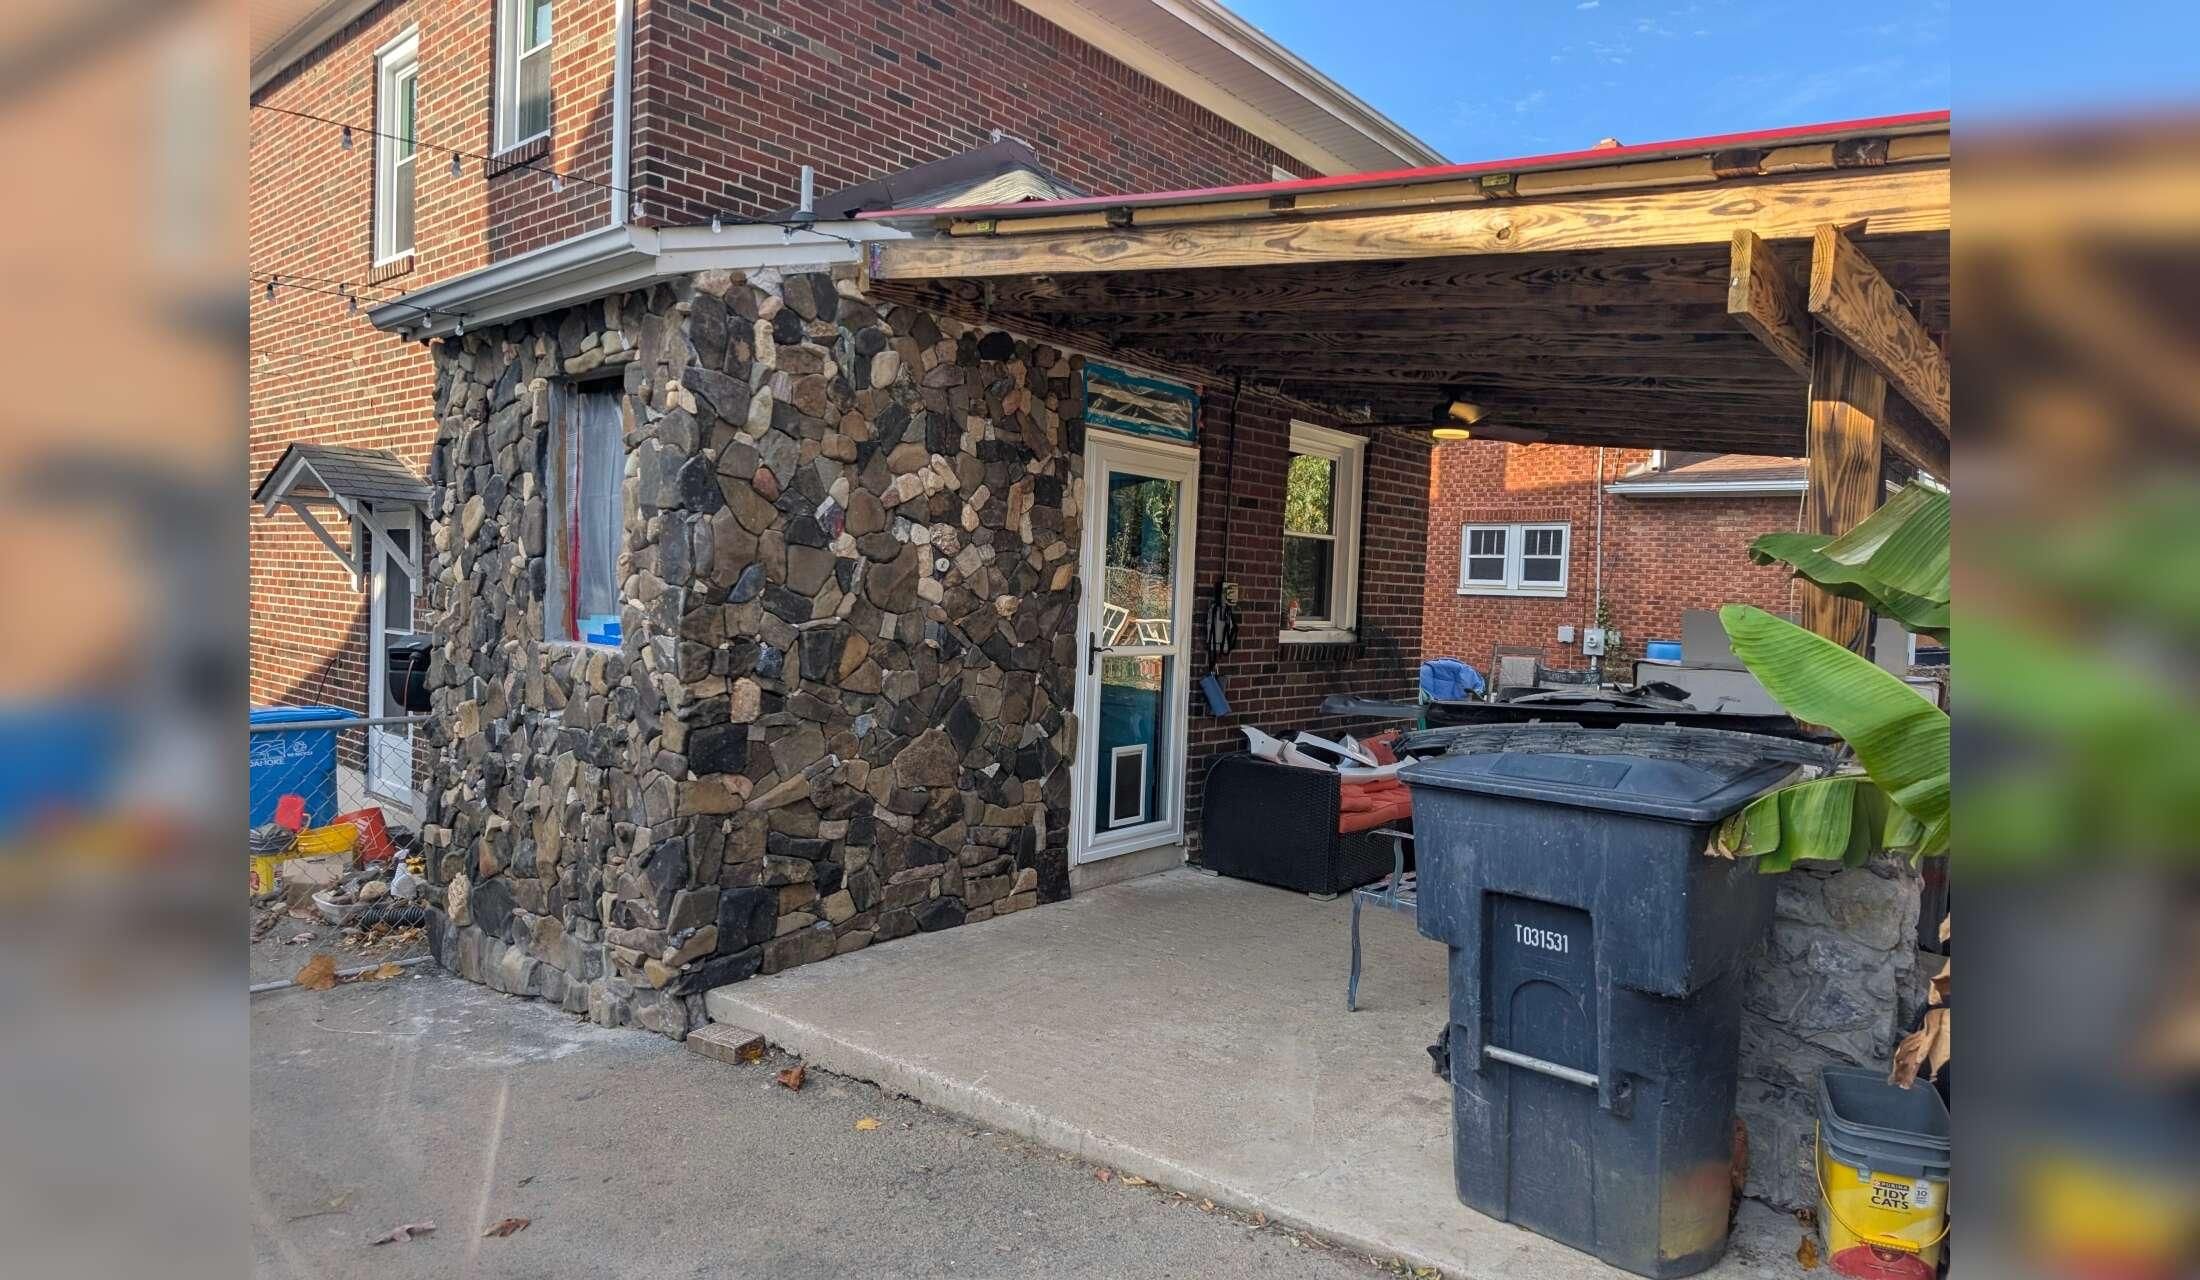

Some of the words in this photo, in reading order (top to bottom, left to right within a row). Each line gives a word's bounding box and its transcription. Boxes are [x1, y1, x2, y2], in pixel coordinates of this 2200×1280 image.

[1514, 923, 1569, 954] T031531
[1873, 1187, 1908, 1200] TIDY
[1871, 1196, 1909, 1210] CATS
